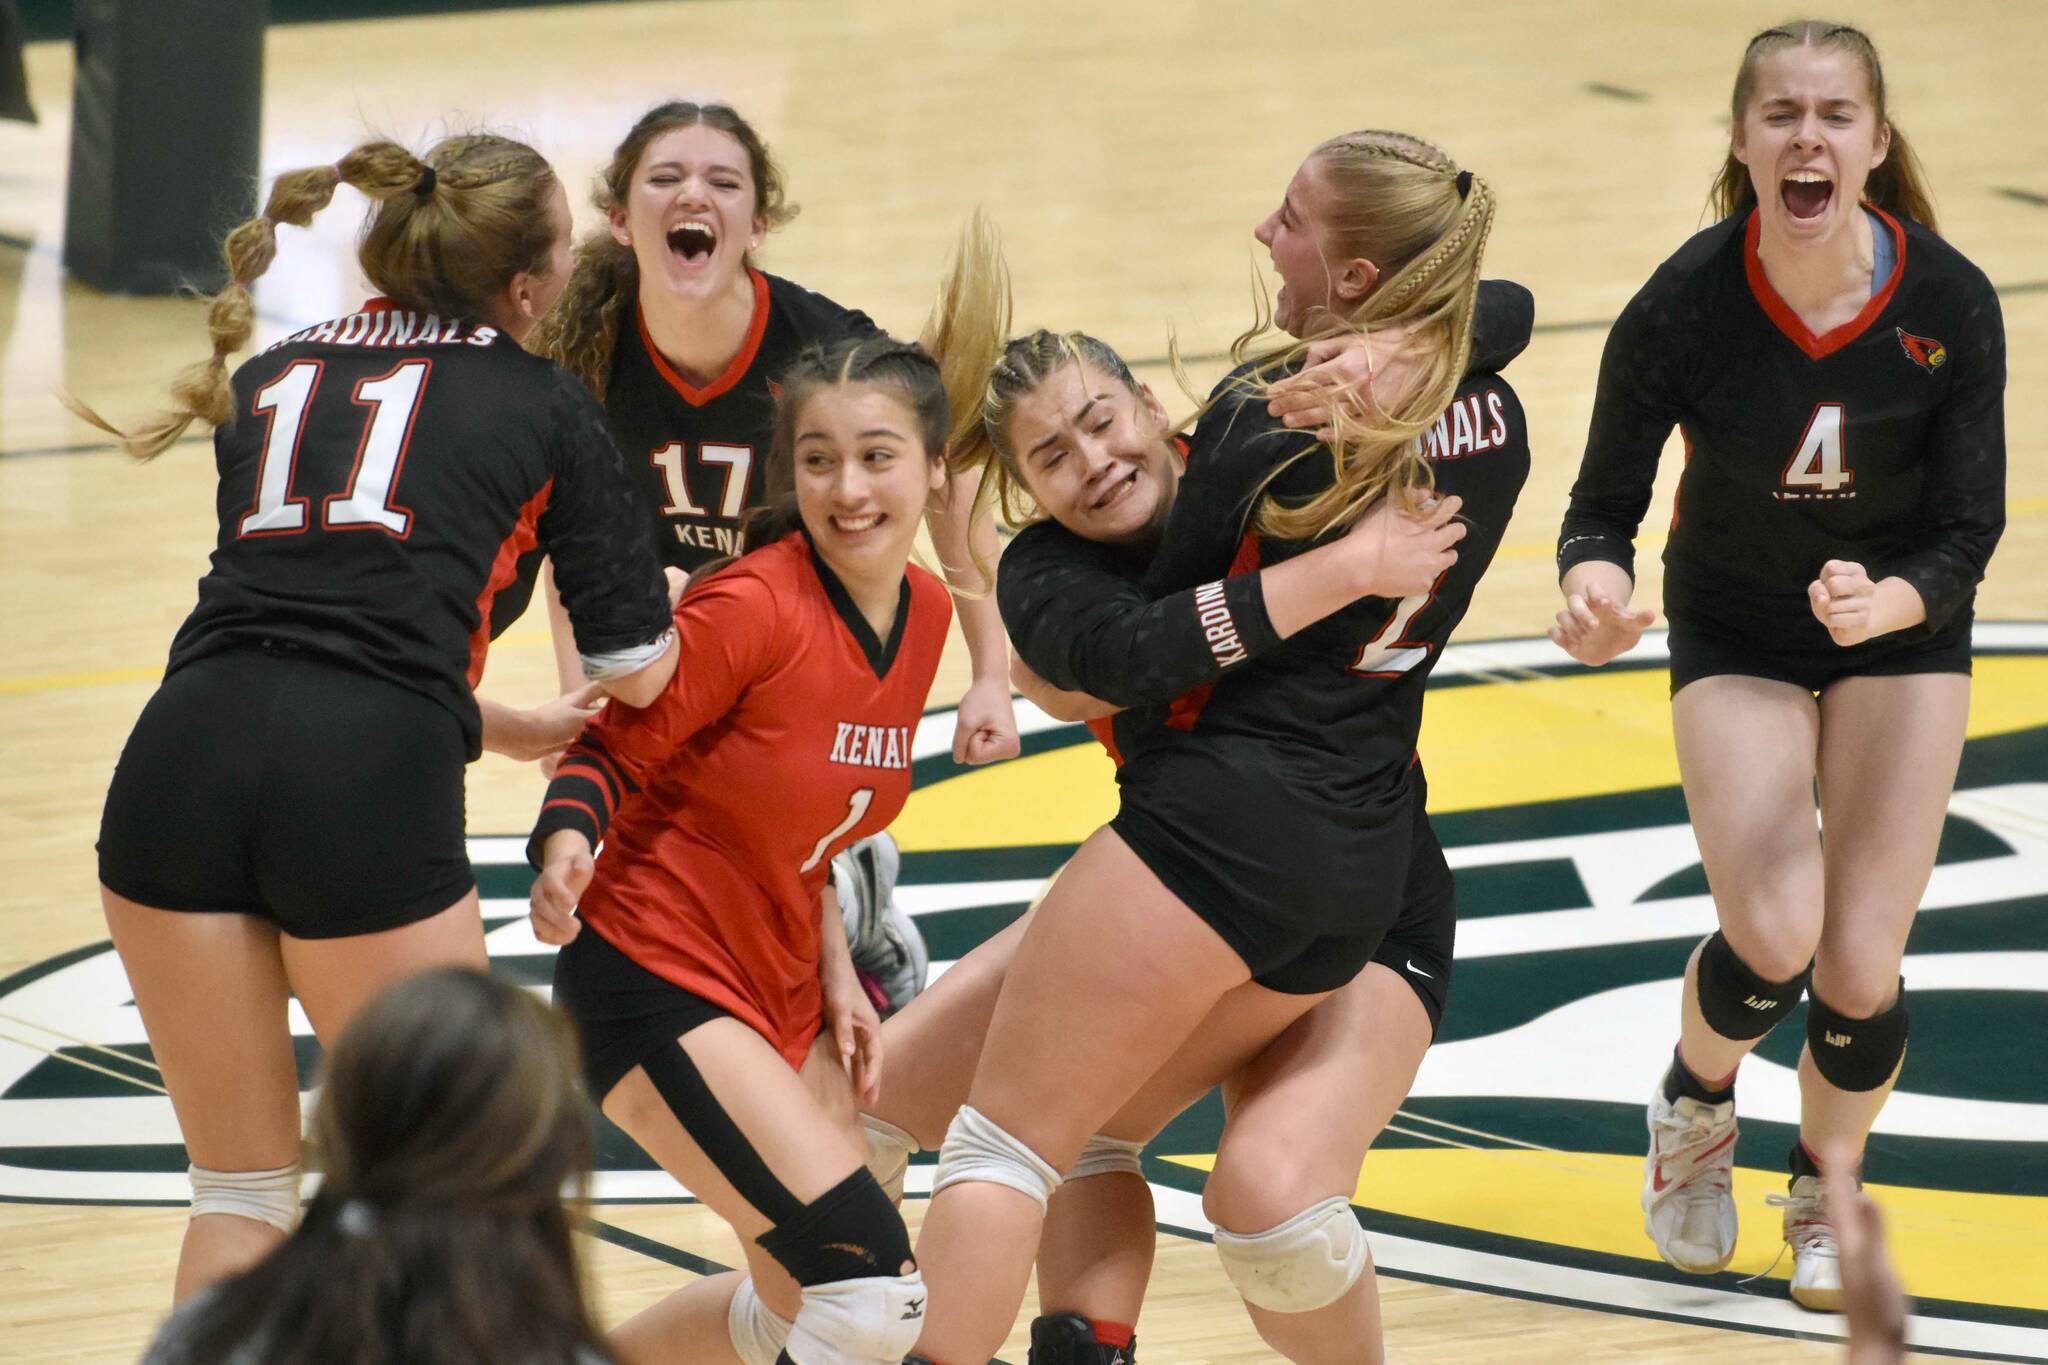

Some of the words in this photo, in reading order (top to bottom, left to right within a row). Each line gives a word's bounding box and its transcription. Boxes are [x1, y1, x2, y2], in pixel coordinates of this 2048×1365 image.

[257, 309, 499, 358] RDINALS
[237, 358, 432, 540] 11
[650, 441, 755, 518] 17
[1780, 401, 1854, 491] 4
[829, 721, 909, 769] KENAI
[799, 786, 875, 874] 1
